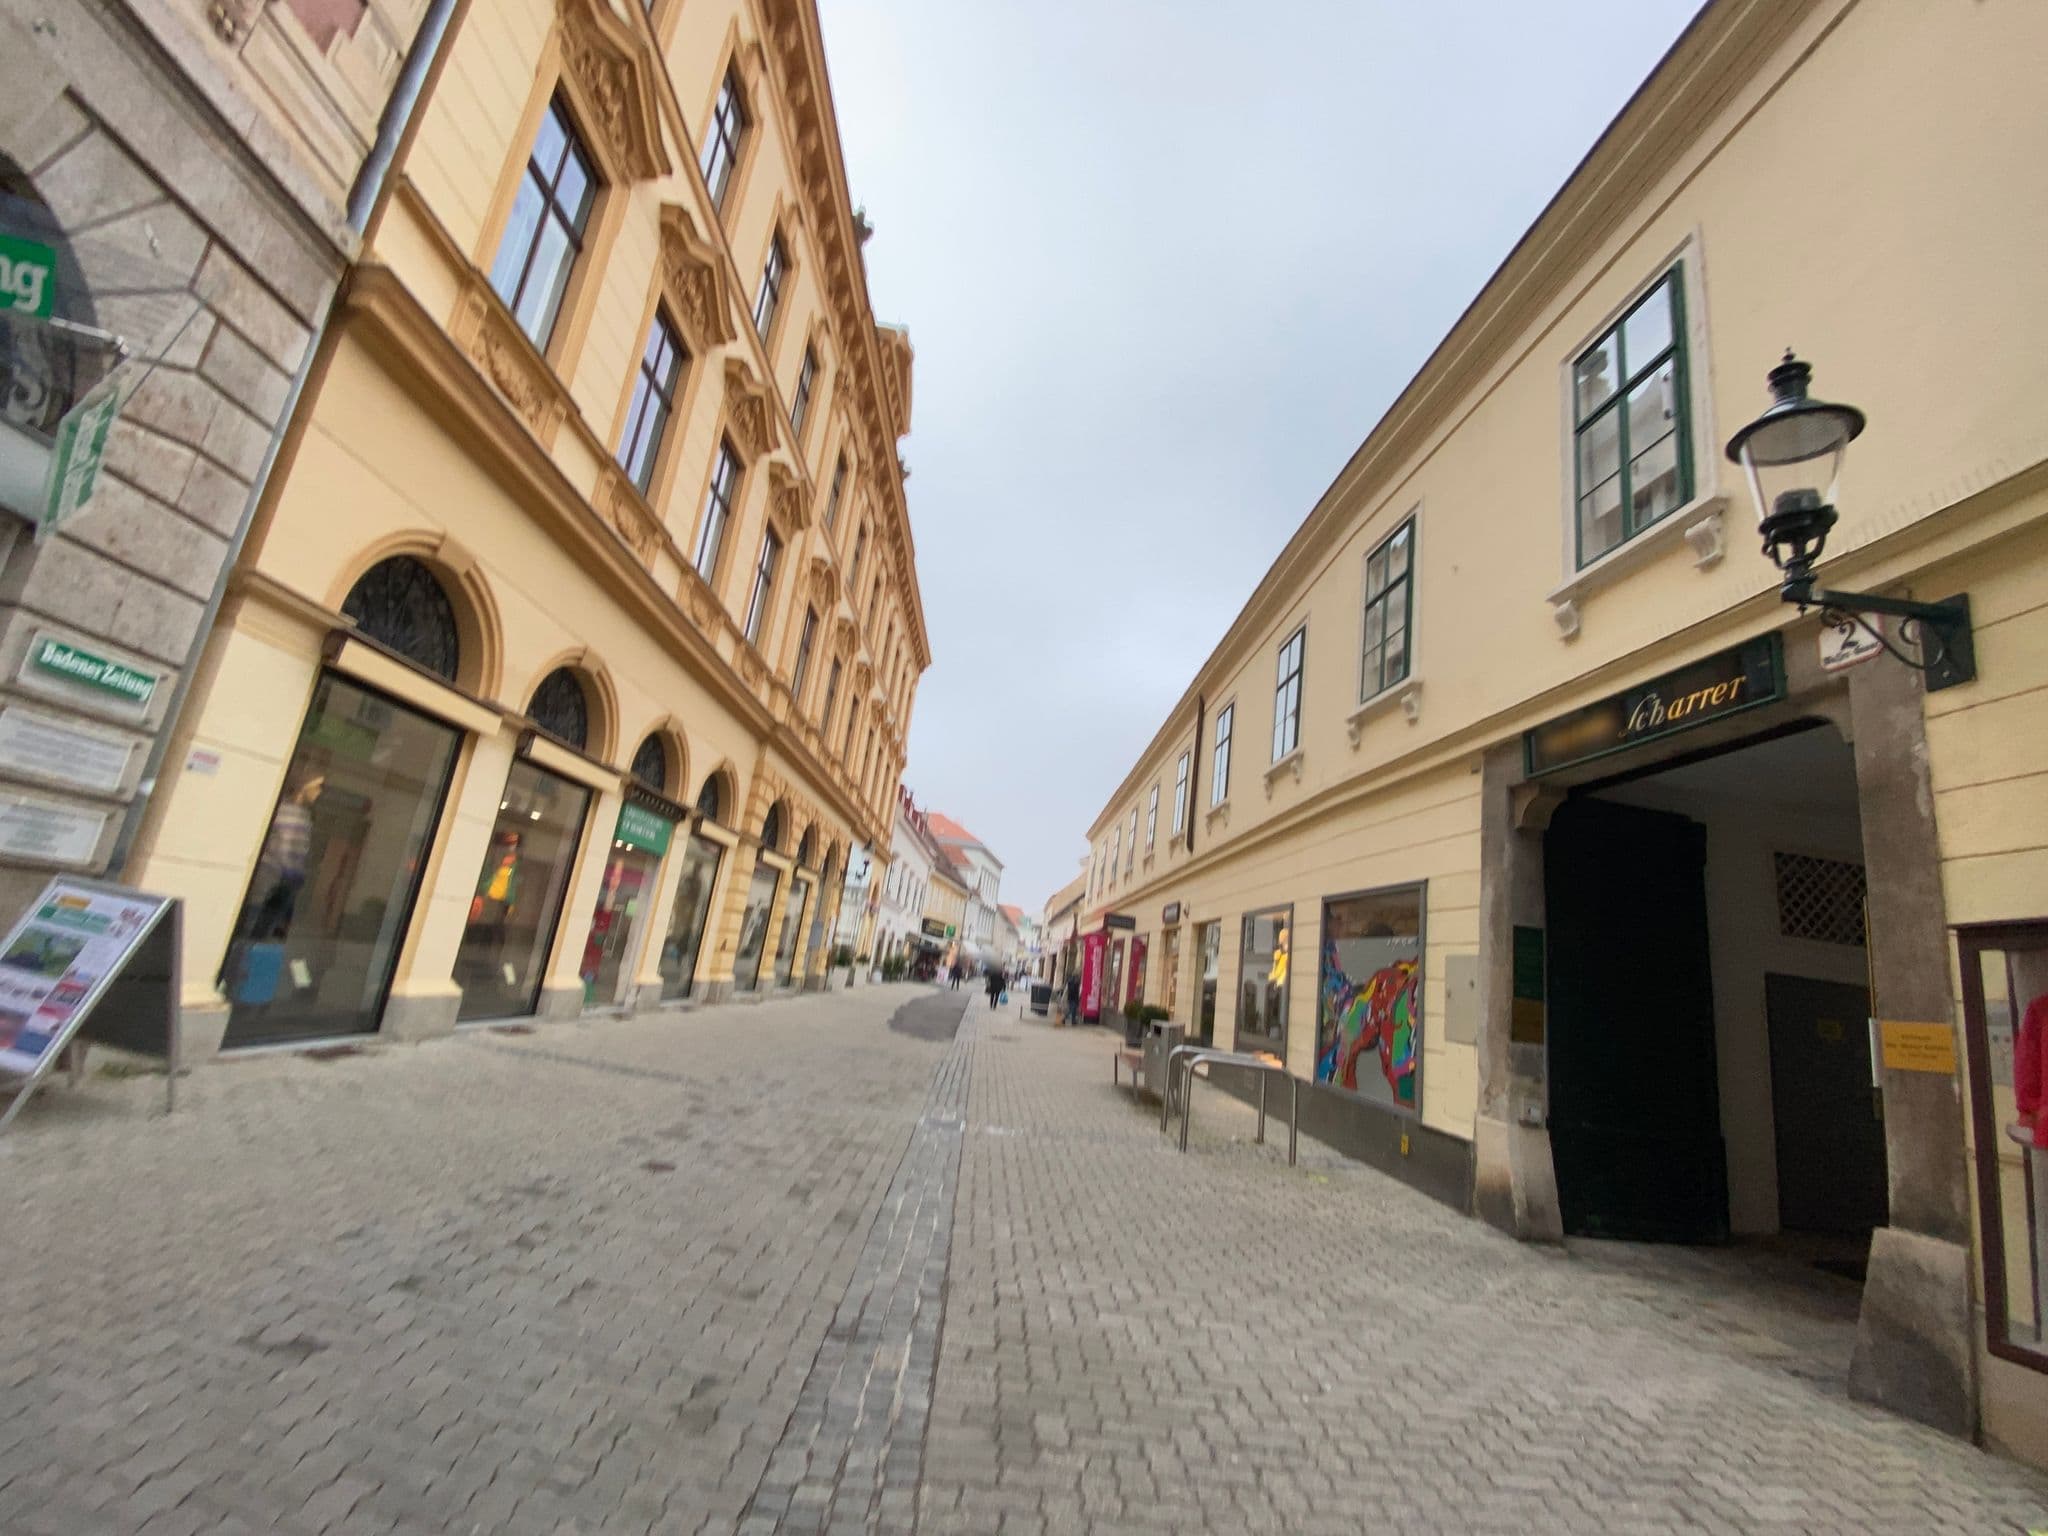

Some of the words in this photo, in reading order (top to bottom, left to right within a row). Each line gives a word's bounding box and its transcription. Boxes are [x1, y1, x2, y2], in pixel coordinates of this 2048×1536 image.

[1839, 621, 1859, 650] 2
[40, 642, 105, 680] Badener
[100, 663, 153, 701] Zeitung
[1617, 675, 1748, 737] Scharrer
